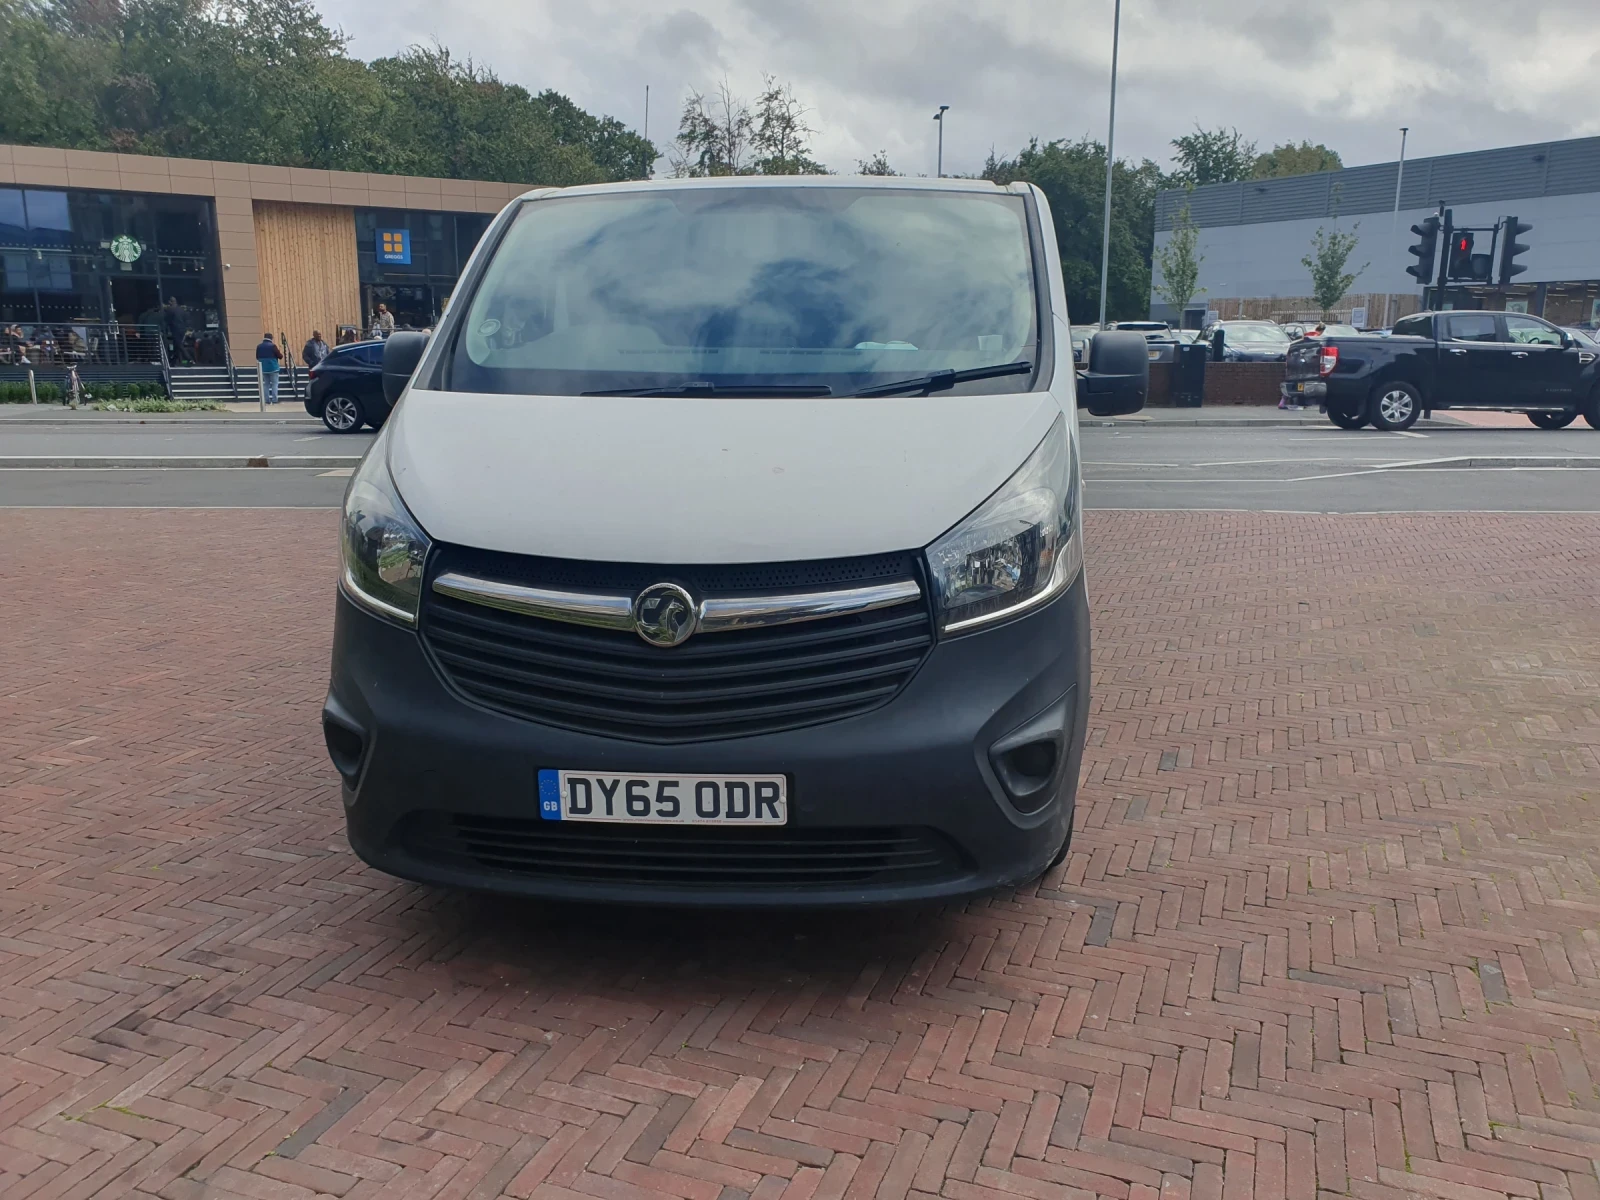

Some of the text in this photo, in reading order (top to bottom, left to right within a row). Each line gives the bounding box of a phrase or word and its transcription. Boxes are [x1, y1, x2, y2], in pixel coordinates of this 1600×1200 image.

[543, 801, 558, 811] GB
[567, 777, 781, 819] DY65 ODR
